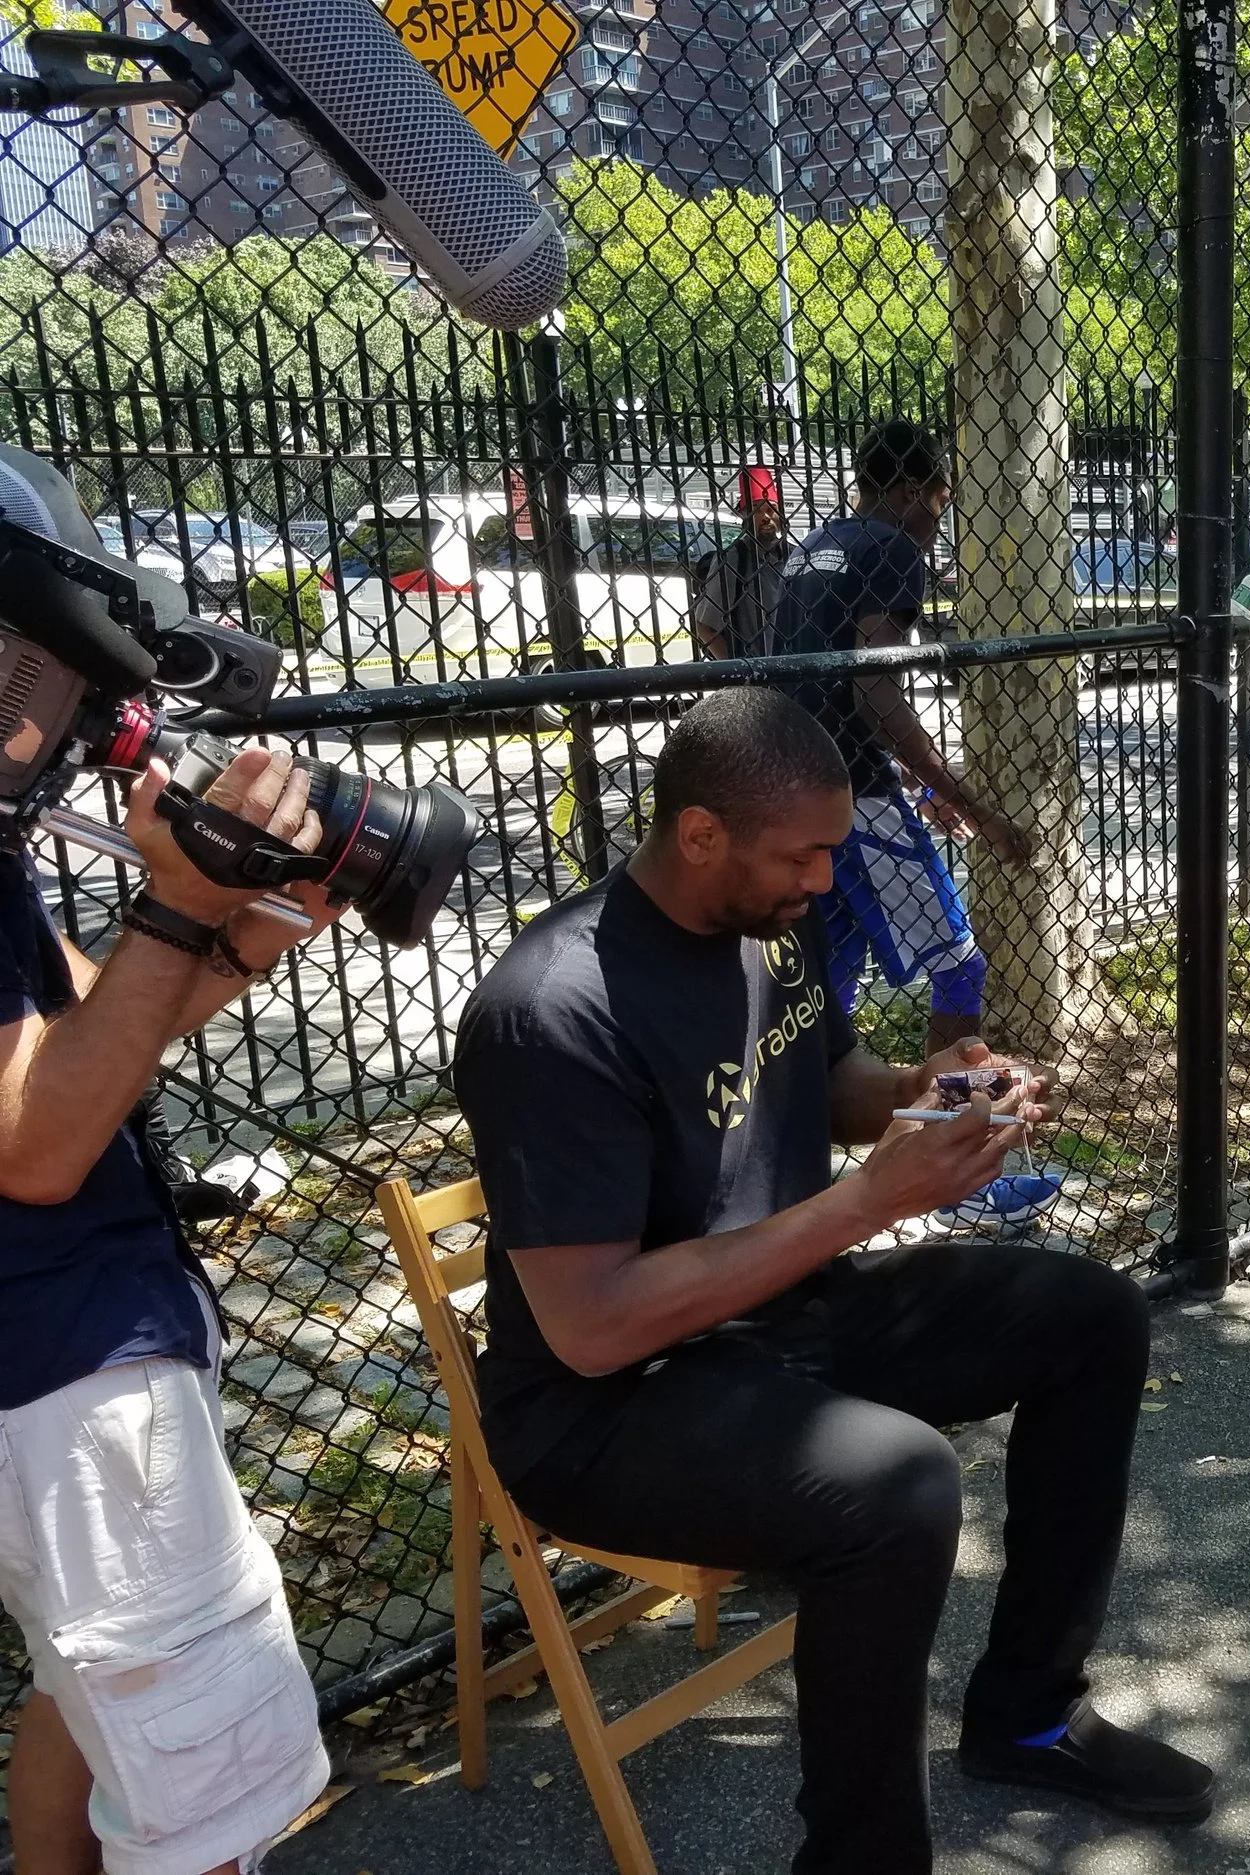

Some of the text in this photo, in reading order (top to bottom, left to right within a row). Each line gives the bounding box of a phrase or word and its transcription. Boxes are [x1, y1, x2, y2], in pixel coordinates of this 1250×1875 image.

[408, 0, 518, 43] SPEED
[193, 821, 237, 852] Canon
[364, 825, 390, 840] Canon
[354, 843, 382, 861] 17-120
